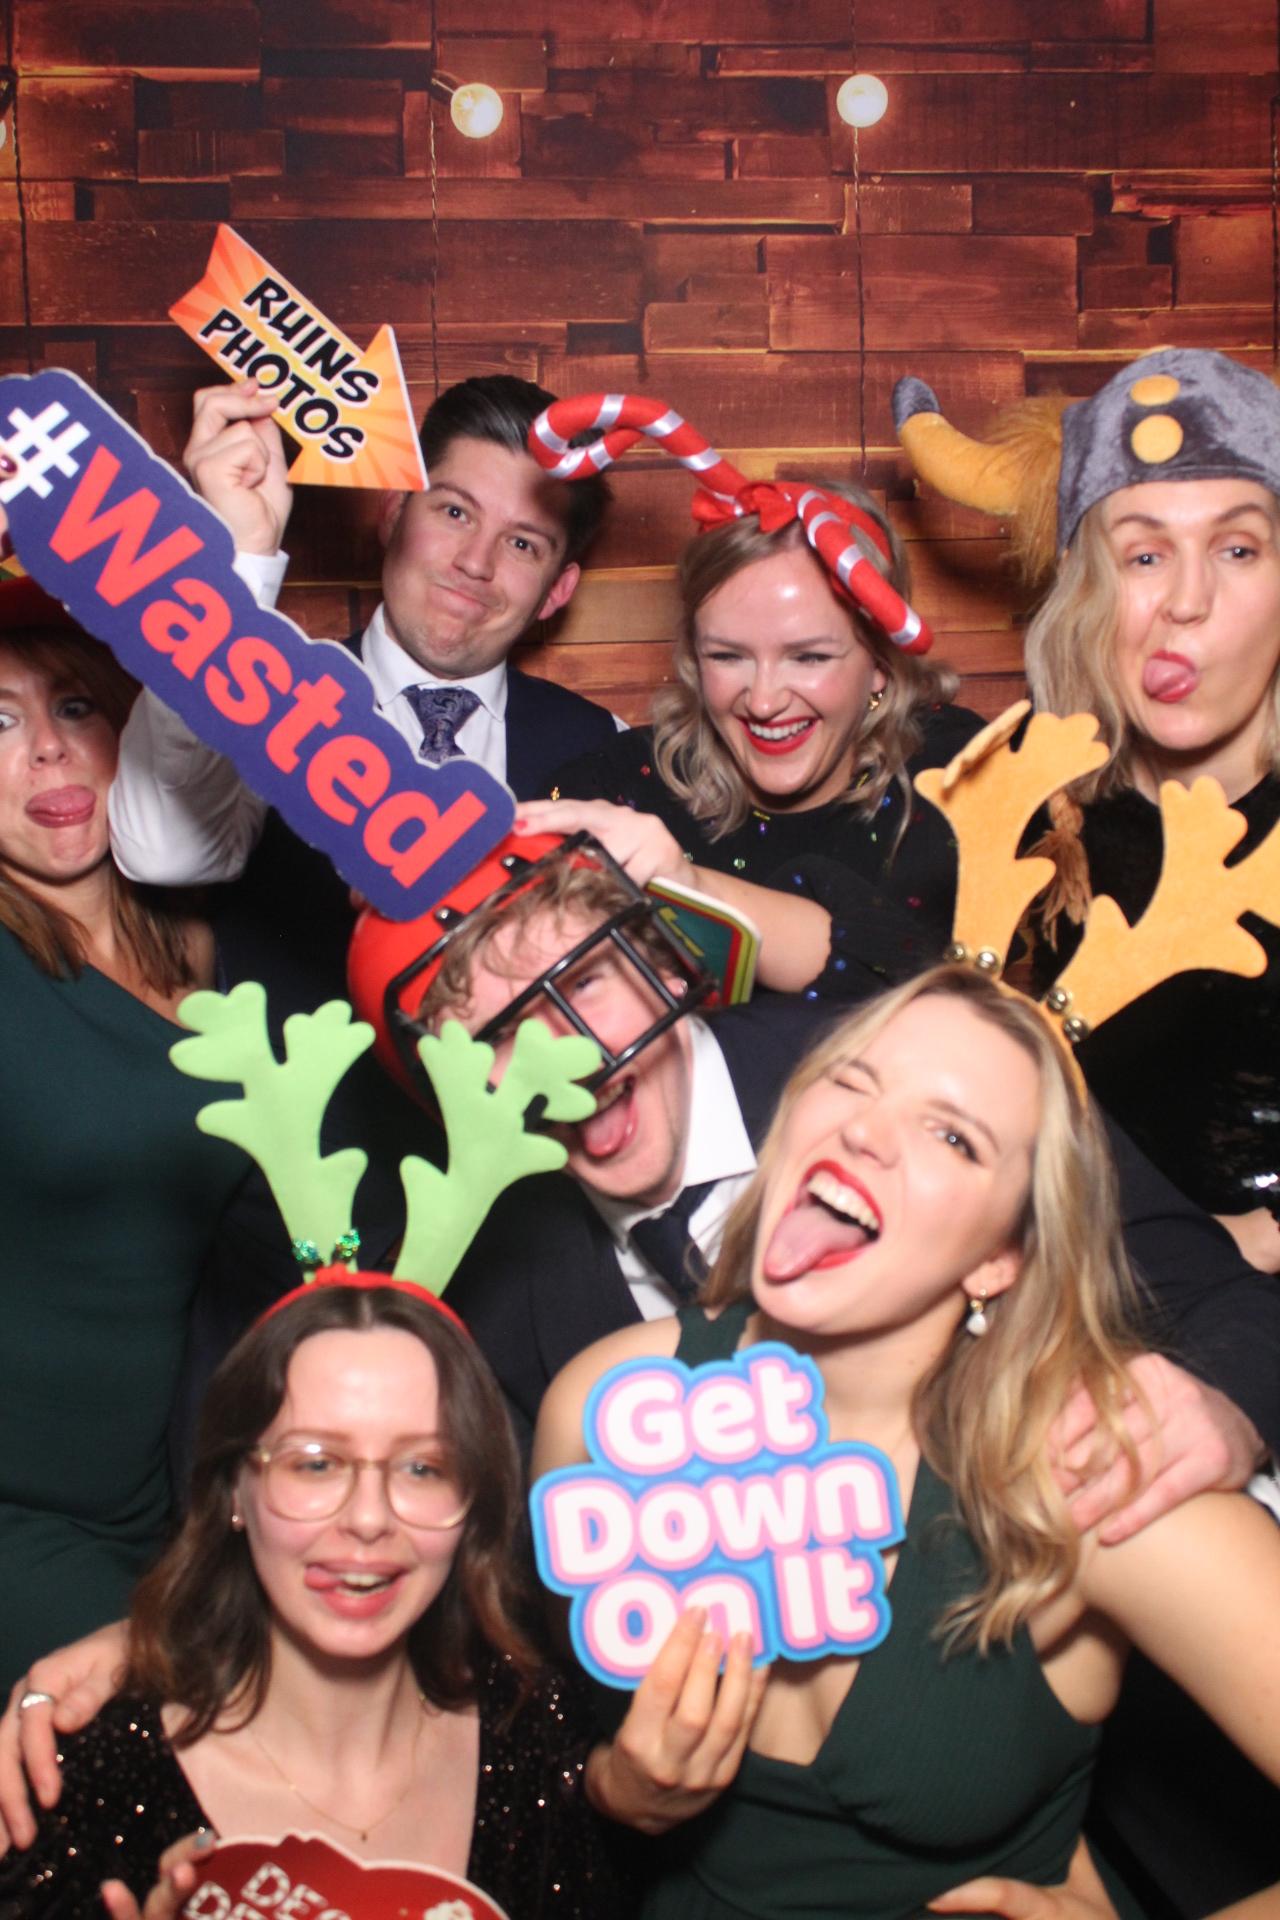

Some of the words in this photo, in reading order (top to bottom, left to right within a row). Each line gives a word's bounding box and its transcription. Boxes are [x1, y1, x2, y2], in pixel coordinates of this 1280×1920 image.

[199, 308, 365, 458] PHOTOS
[243, 276, 379, 403] RUINS
[0, 400, 488, 889] #Wasted
[605, 1365, 817, 1466] Get
[552, 1463, 884, 1575] Down
[593, 1578, 754, 1668] On
[782, 1550, 872, 1640] It
